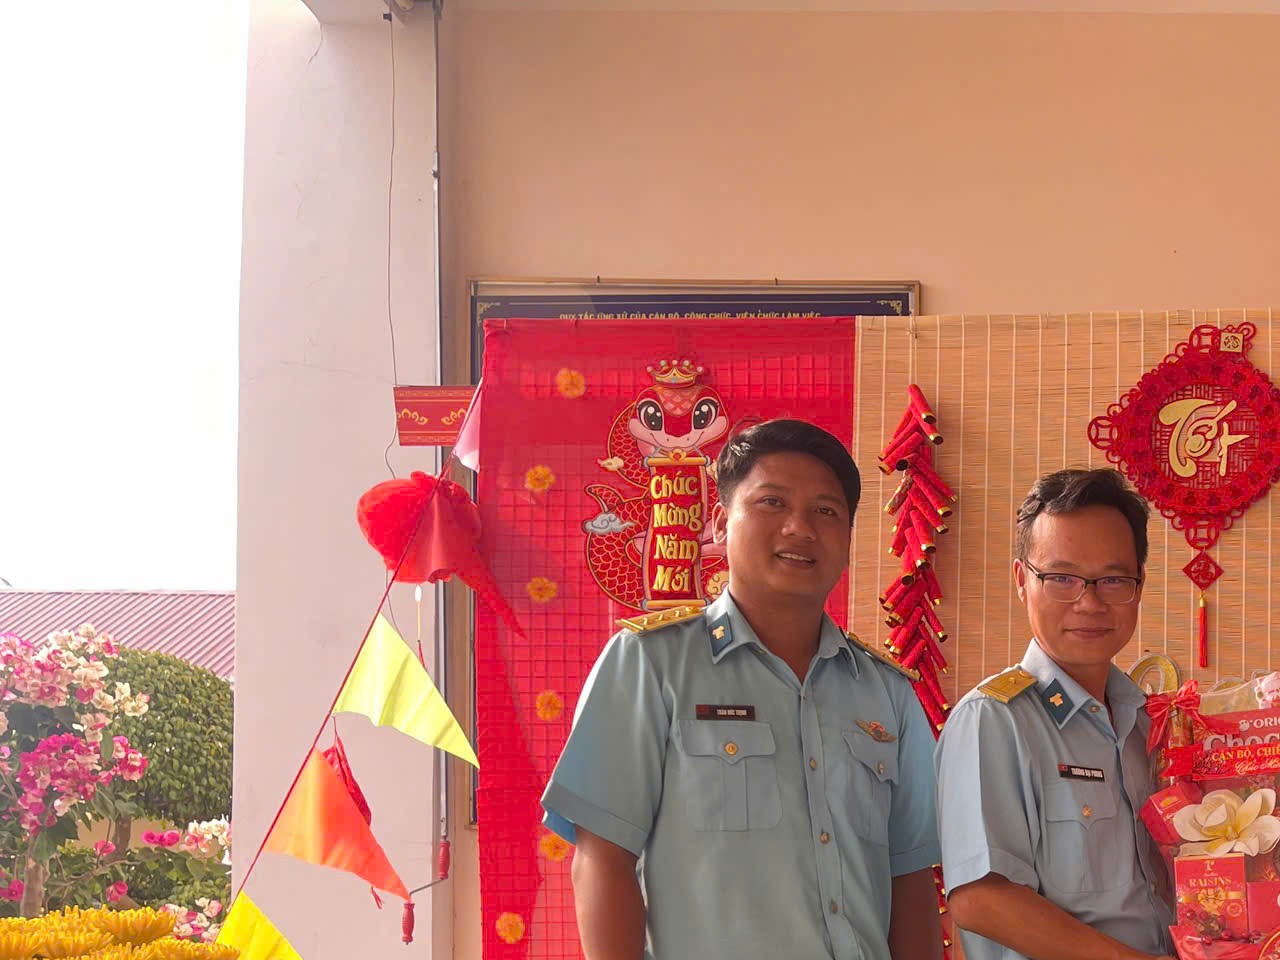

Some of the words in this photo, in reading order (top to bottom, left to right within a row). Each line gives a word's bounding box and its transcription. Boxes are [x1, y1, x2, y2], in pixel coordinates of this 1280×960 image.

[1158, 398, 1250, 478] Tết
[650, 470, 698, 499] Chúc
[652, 502, 703, 532] Mừng
[654, 533, 699, 561] Năm
[652, 565, 690, 592] Mới
[1189, 876, 1232, 887] RAISINS
